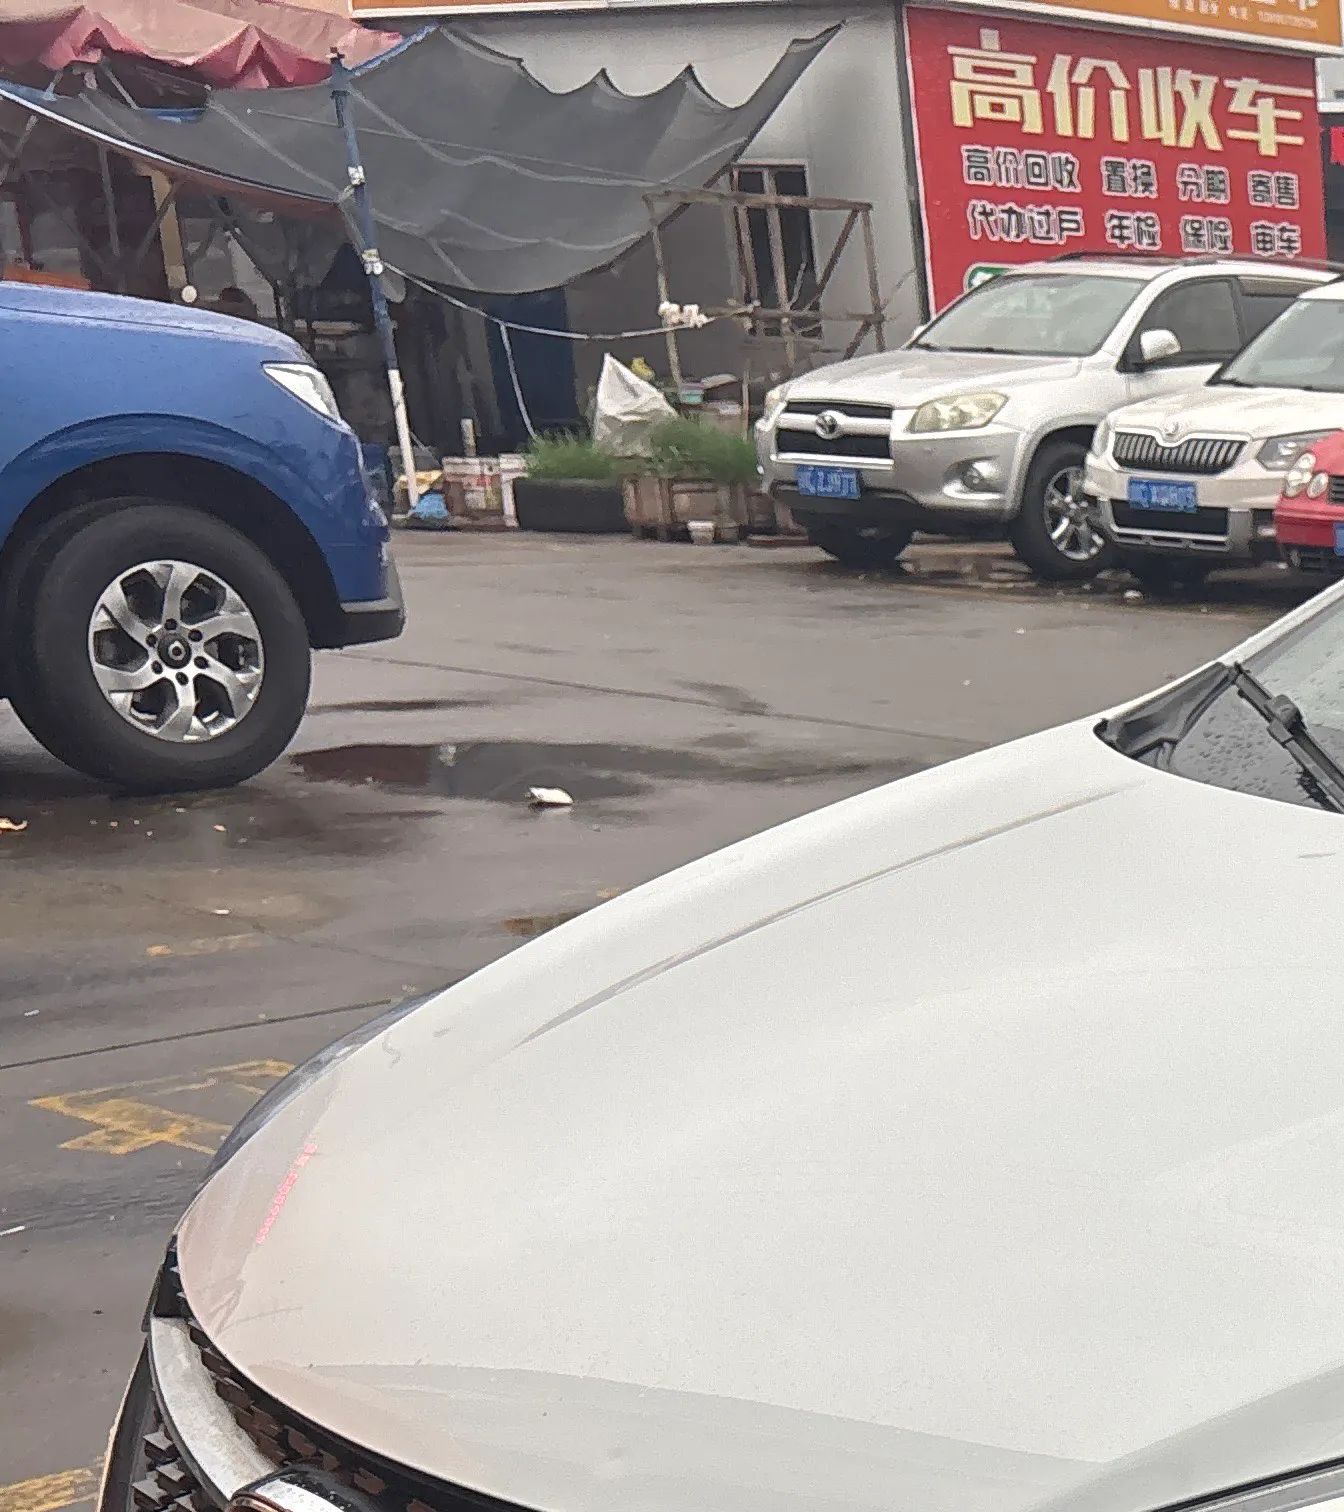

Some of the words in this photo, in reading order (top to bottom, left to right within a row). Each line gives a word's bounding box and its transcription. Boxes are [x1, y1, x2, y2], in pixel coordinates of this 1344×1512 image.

[947, 28, 1315, 156] 高价收车
[961, 144, 1081, 193] 高价回收
[1100, 156, 1159, 199] 置换
[967, 199, 1086, 245] 代办过户
[1178, 214, 1233, 254] 保险
[1250, 219, 1302, 258] 审车
